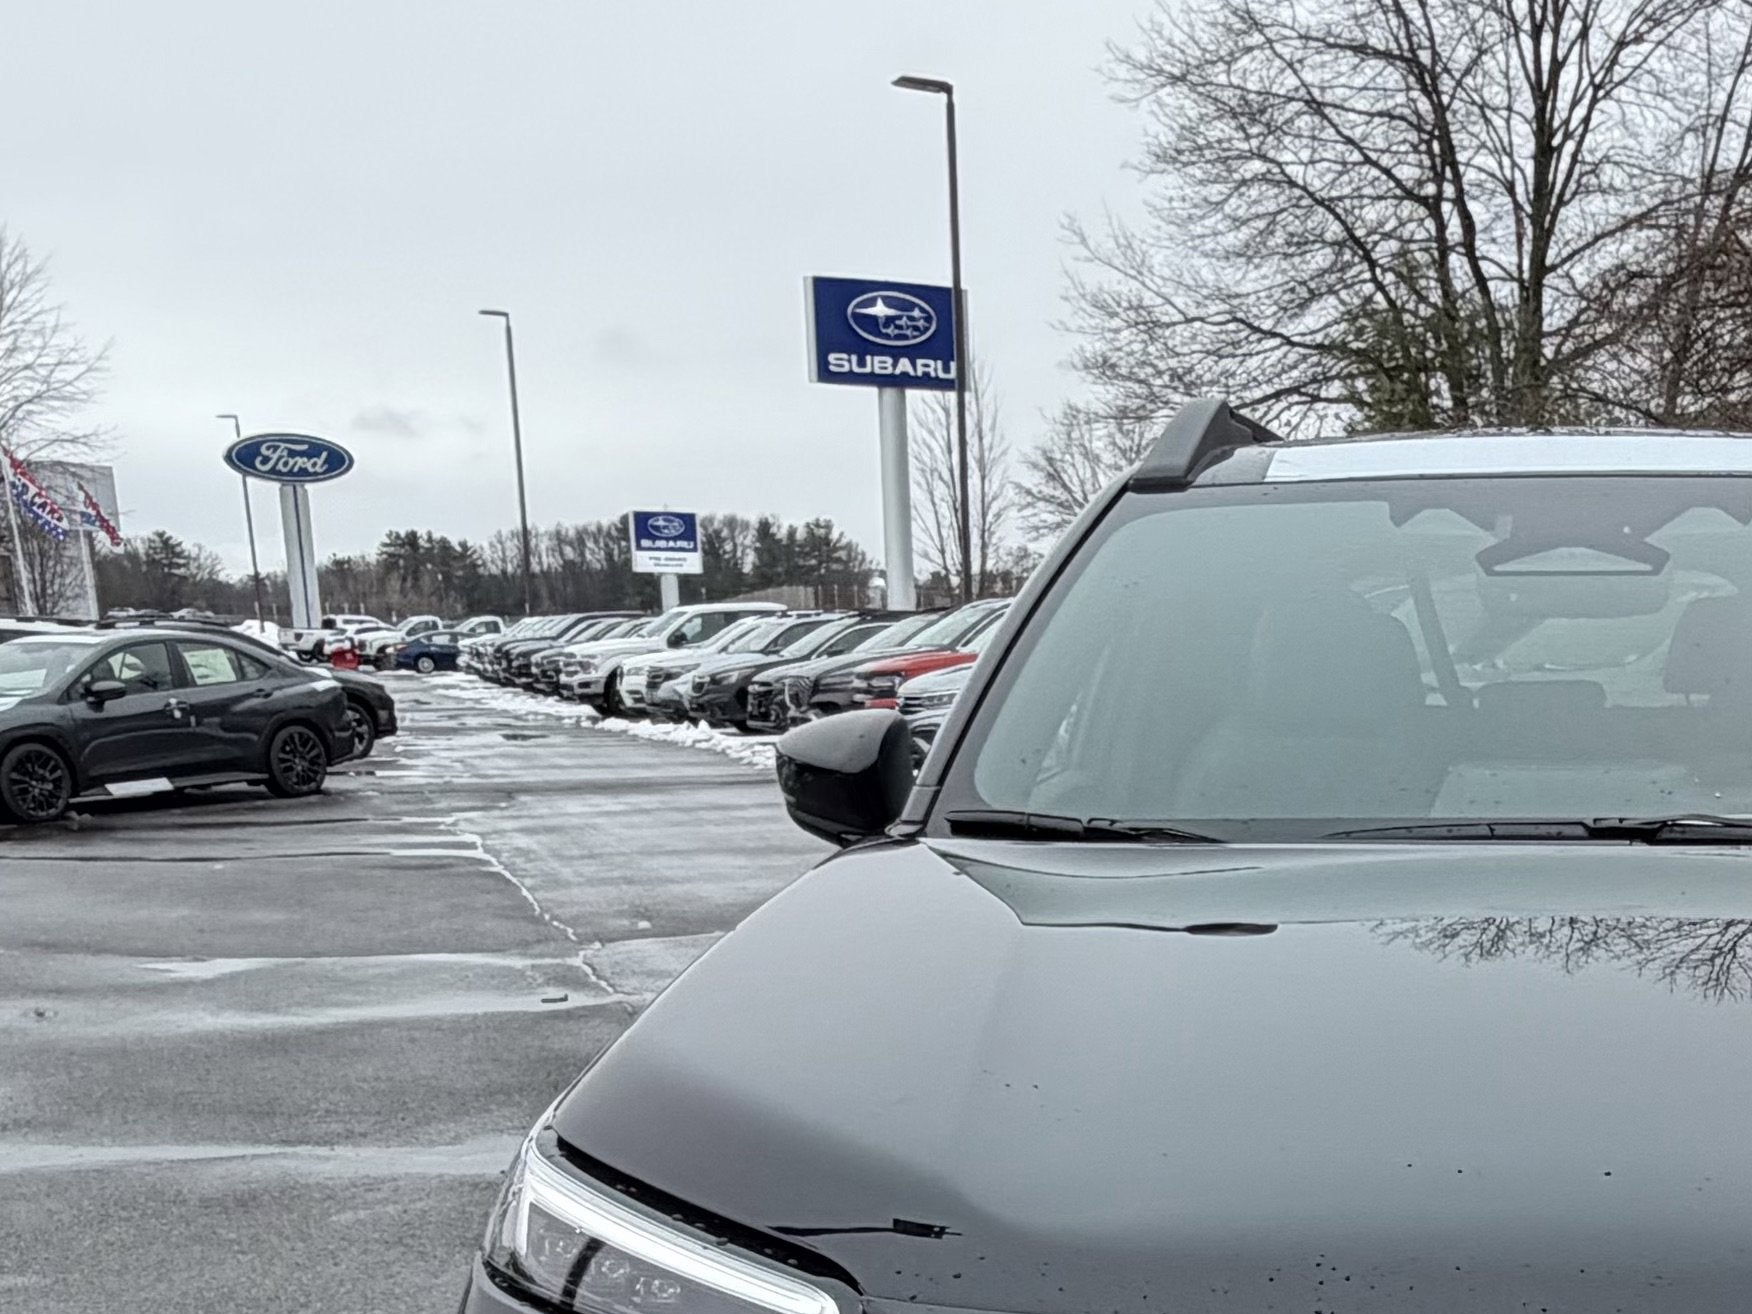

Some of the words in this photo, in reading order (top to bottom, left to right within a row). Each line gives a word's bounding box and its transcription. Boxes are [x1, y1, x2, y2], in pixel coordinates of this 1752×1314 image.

[827, 352, 956, 380] SUBARU
[254, 441, 329, 472] Ford
[640, 538, 695, 549] SUBARU
